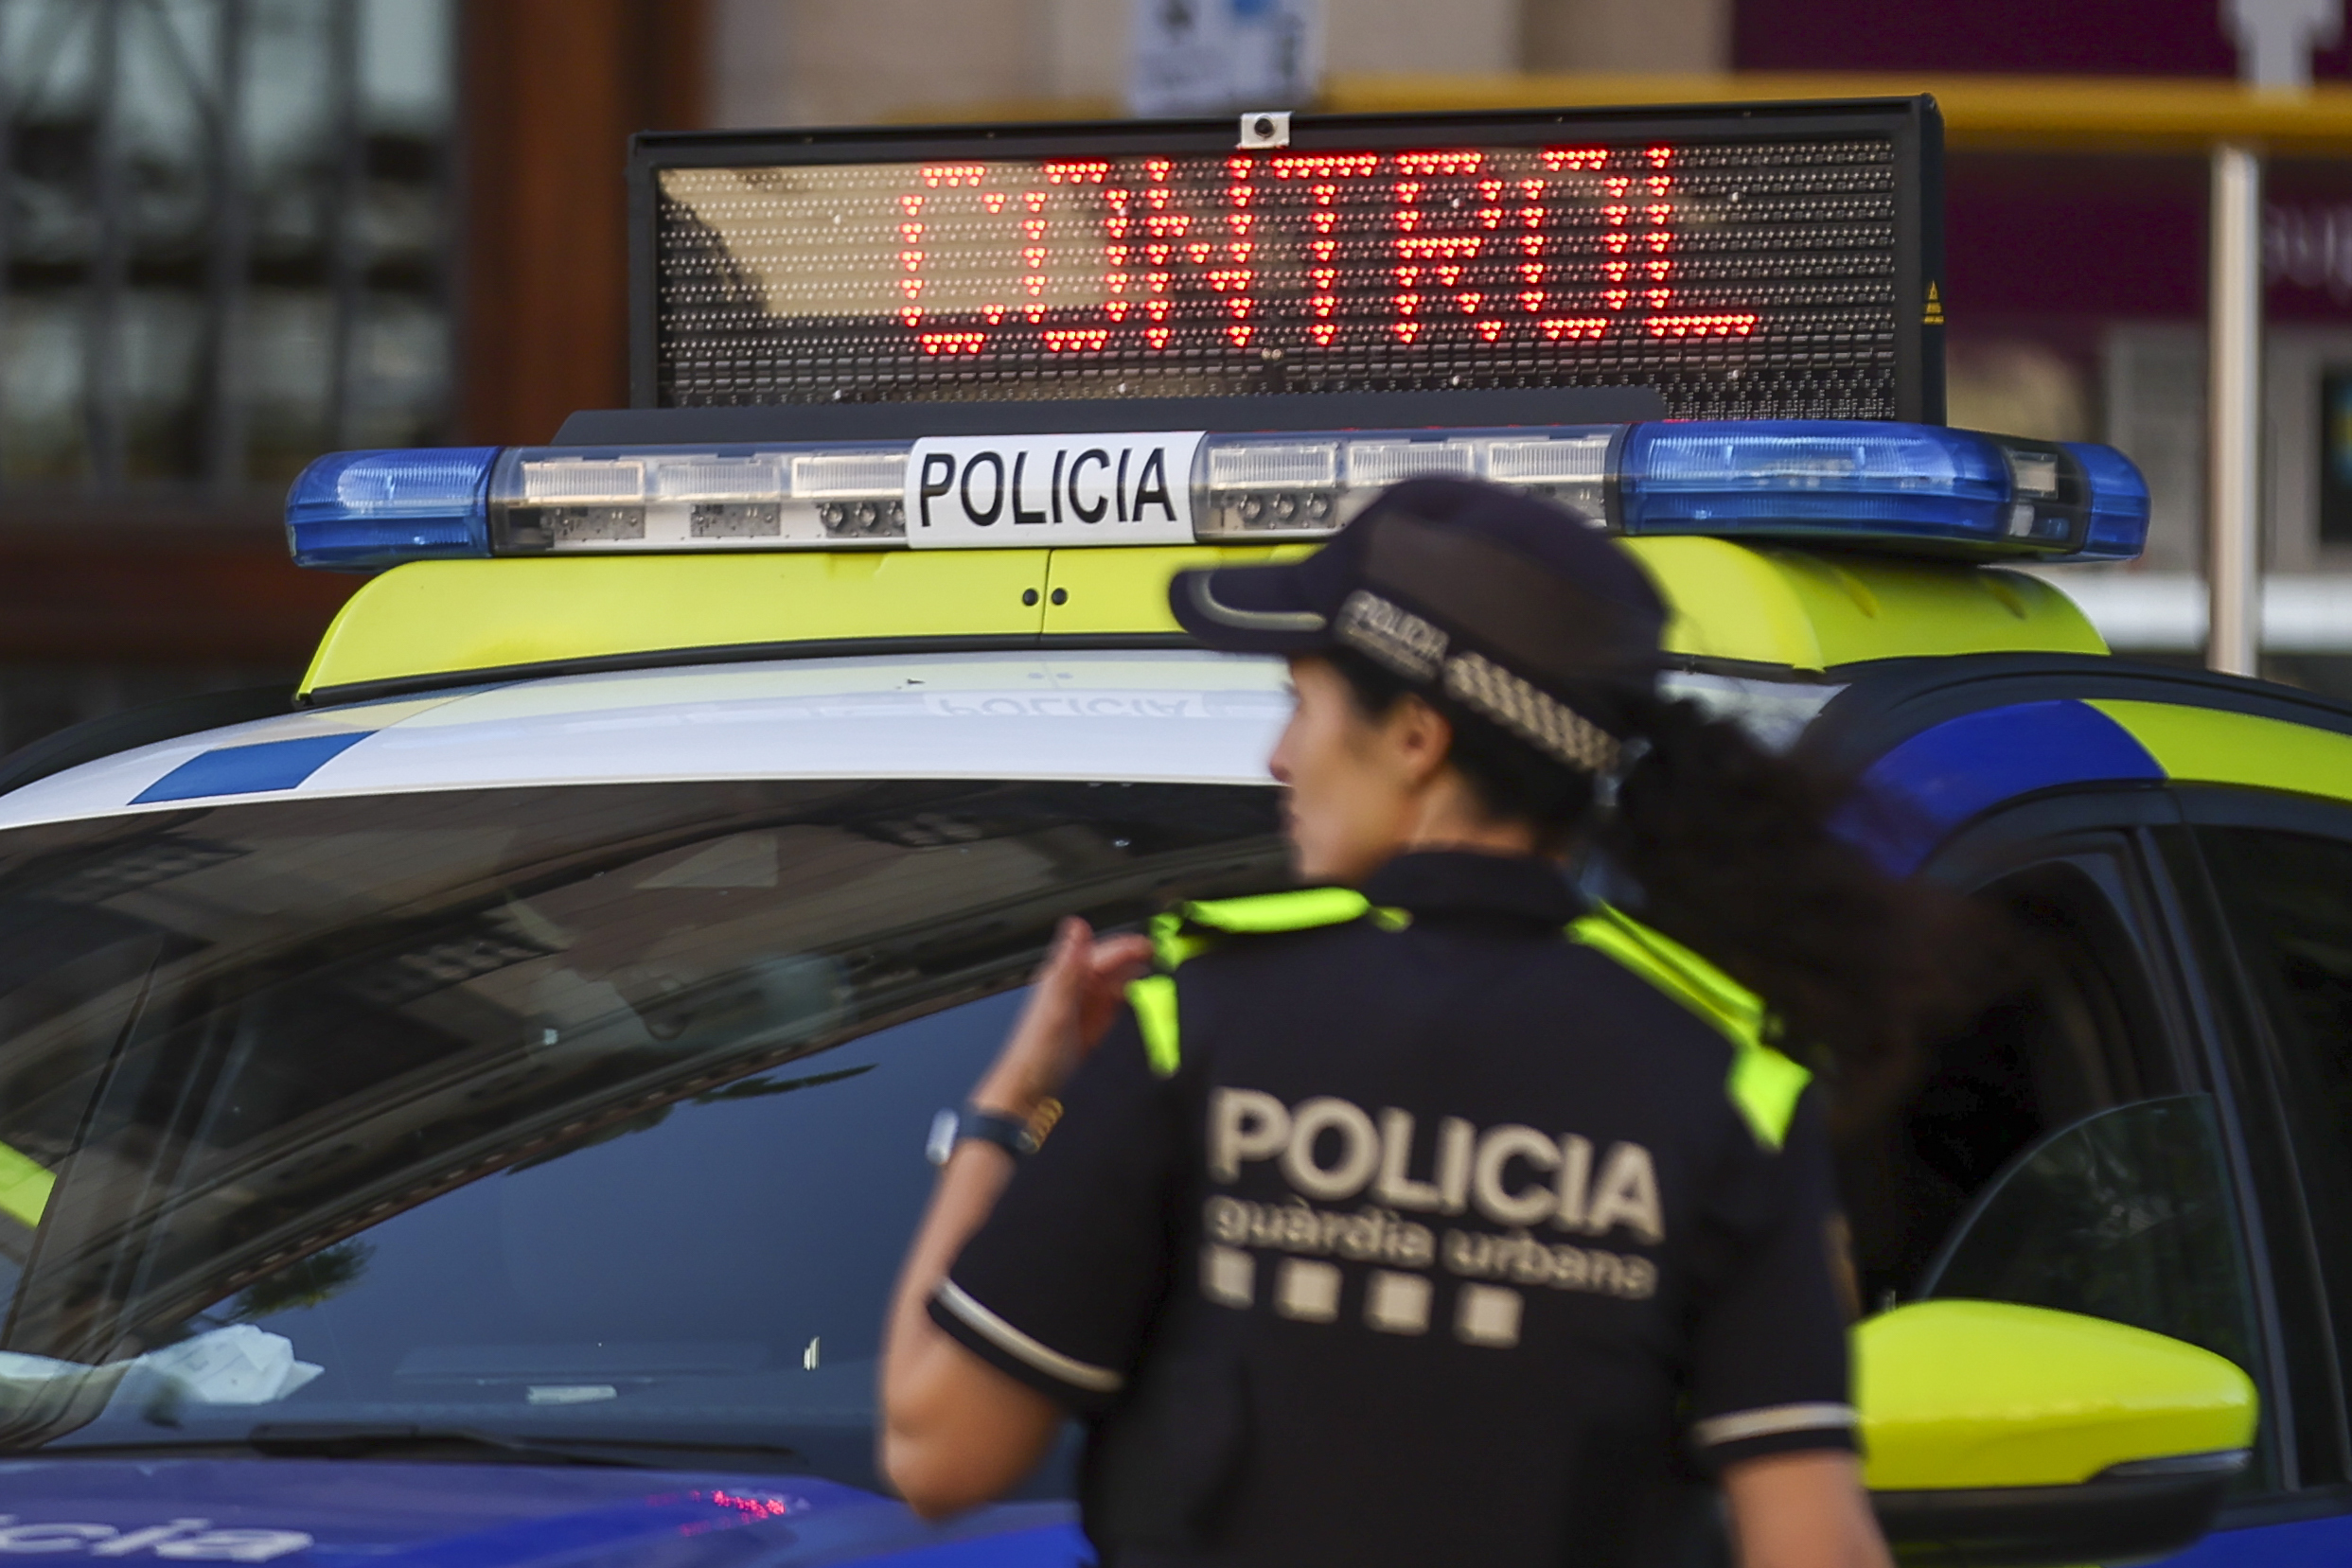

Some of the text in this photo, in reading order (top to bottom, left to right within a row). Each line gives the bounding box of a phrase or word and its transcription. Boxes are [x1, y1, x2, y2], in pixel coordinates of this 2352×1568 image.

[899, 145, 1757, 356] CONTROL
[919, 447, 1178, 528] POLICIA
[1207, 1085, 1665, 1247] POLICIA
[1441, 1227, 1659, 1300] urbana
